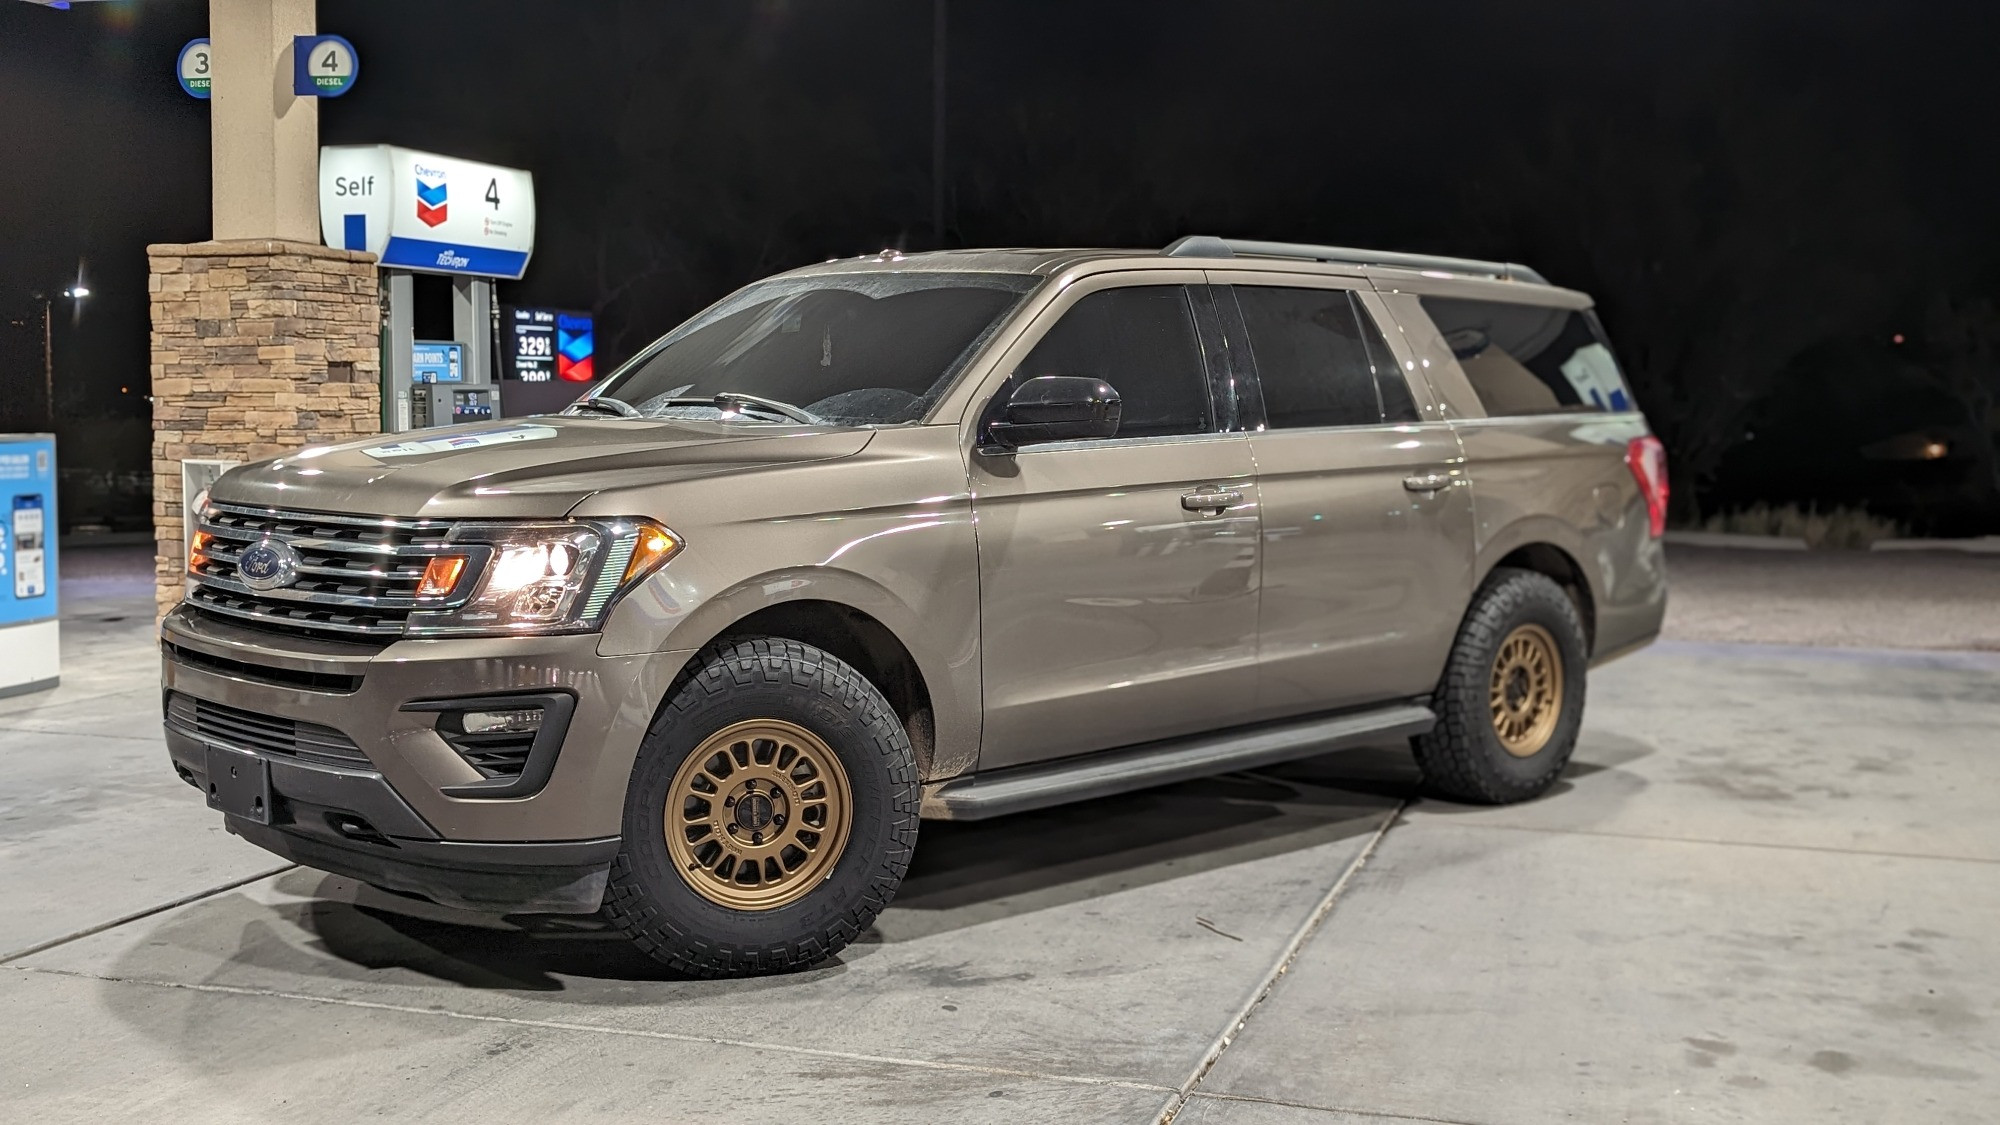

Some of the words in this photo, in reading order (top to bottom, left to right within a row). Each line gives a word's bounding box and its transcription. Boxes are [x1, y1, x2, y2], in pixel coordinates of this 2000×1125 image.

[194, 52, 209, 74] 3
[321, 50, 338, 72] 4
[190, 80, 211, 88] DIESE
[316, 77, 343, 86] DIESEL
[415, 164, 447, 179] Chevron
[335, 176, 375, 197] Self
[485, 177, 500, 211] 4
[436, 253, 470, 268] TECHRON
[519, 336, 545, 355] 329
[412, 352, 424, 364] ARN
[424, 352, 443, 364] POINTS
[245, 550, 272, 574] Ford
